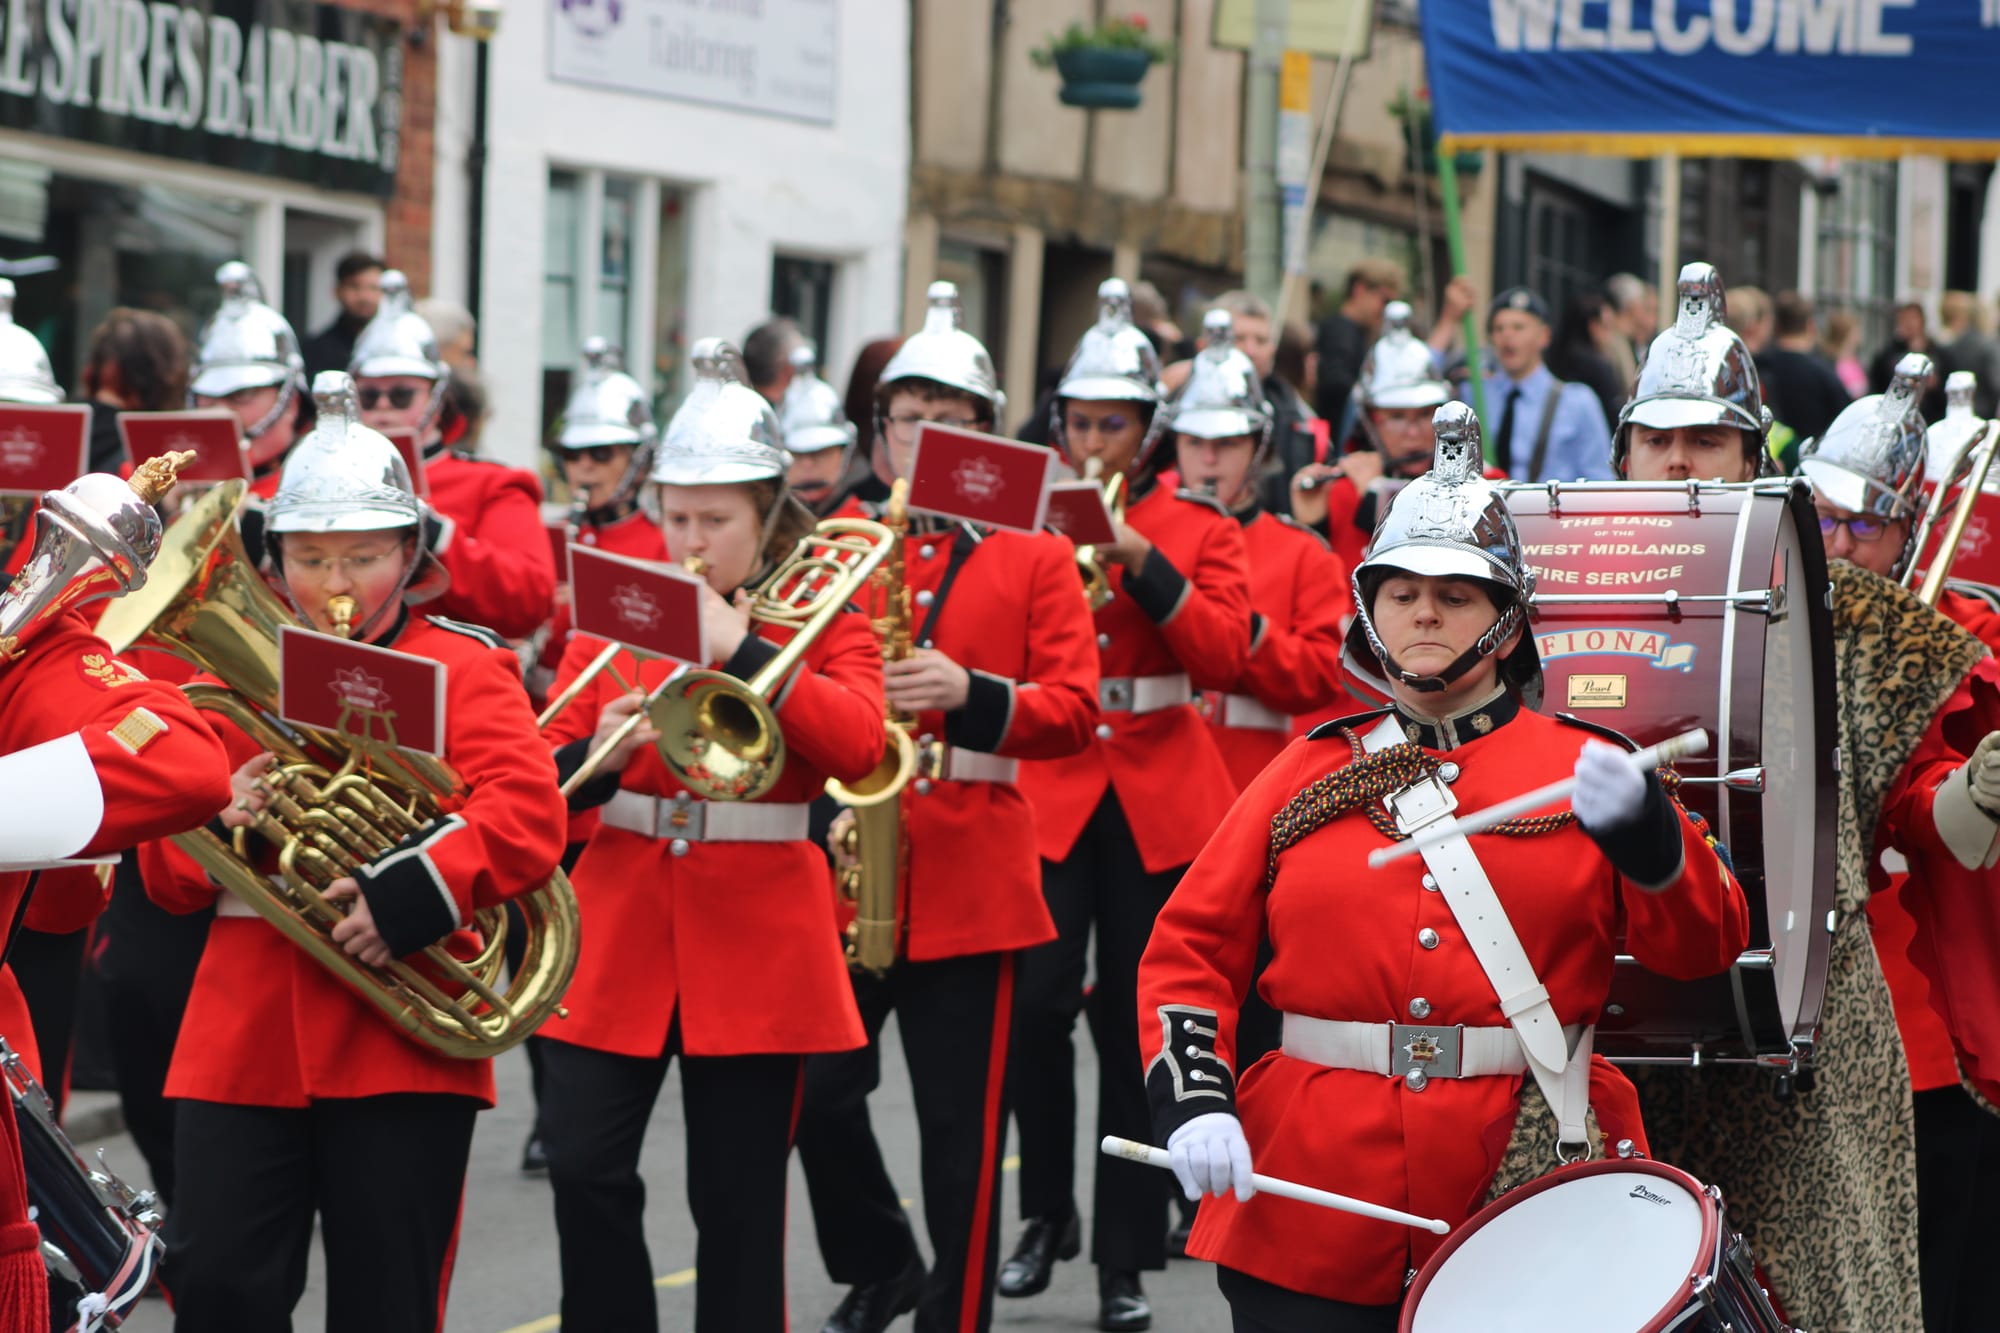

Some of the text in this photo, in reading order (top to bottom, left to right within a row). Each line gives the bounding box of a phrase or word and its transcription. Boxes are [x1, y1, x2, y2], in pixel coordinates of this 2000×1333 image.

[41, 0, 201, 129] SPIRES
[204, 15, 380, 163] BARBER
[1560, 516, 1673, 529] THE BAND
[1521, 544, 1706, 556] WEST MIDLANDS
[1531, 565, 1684, 585] FIRE SERVICE
[1541, 631, 1658, 656] FIONA
[1582, 680, 1613, 694] Pearl
[1633, 1185, 1671, 1205] Premier
